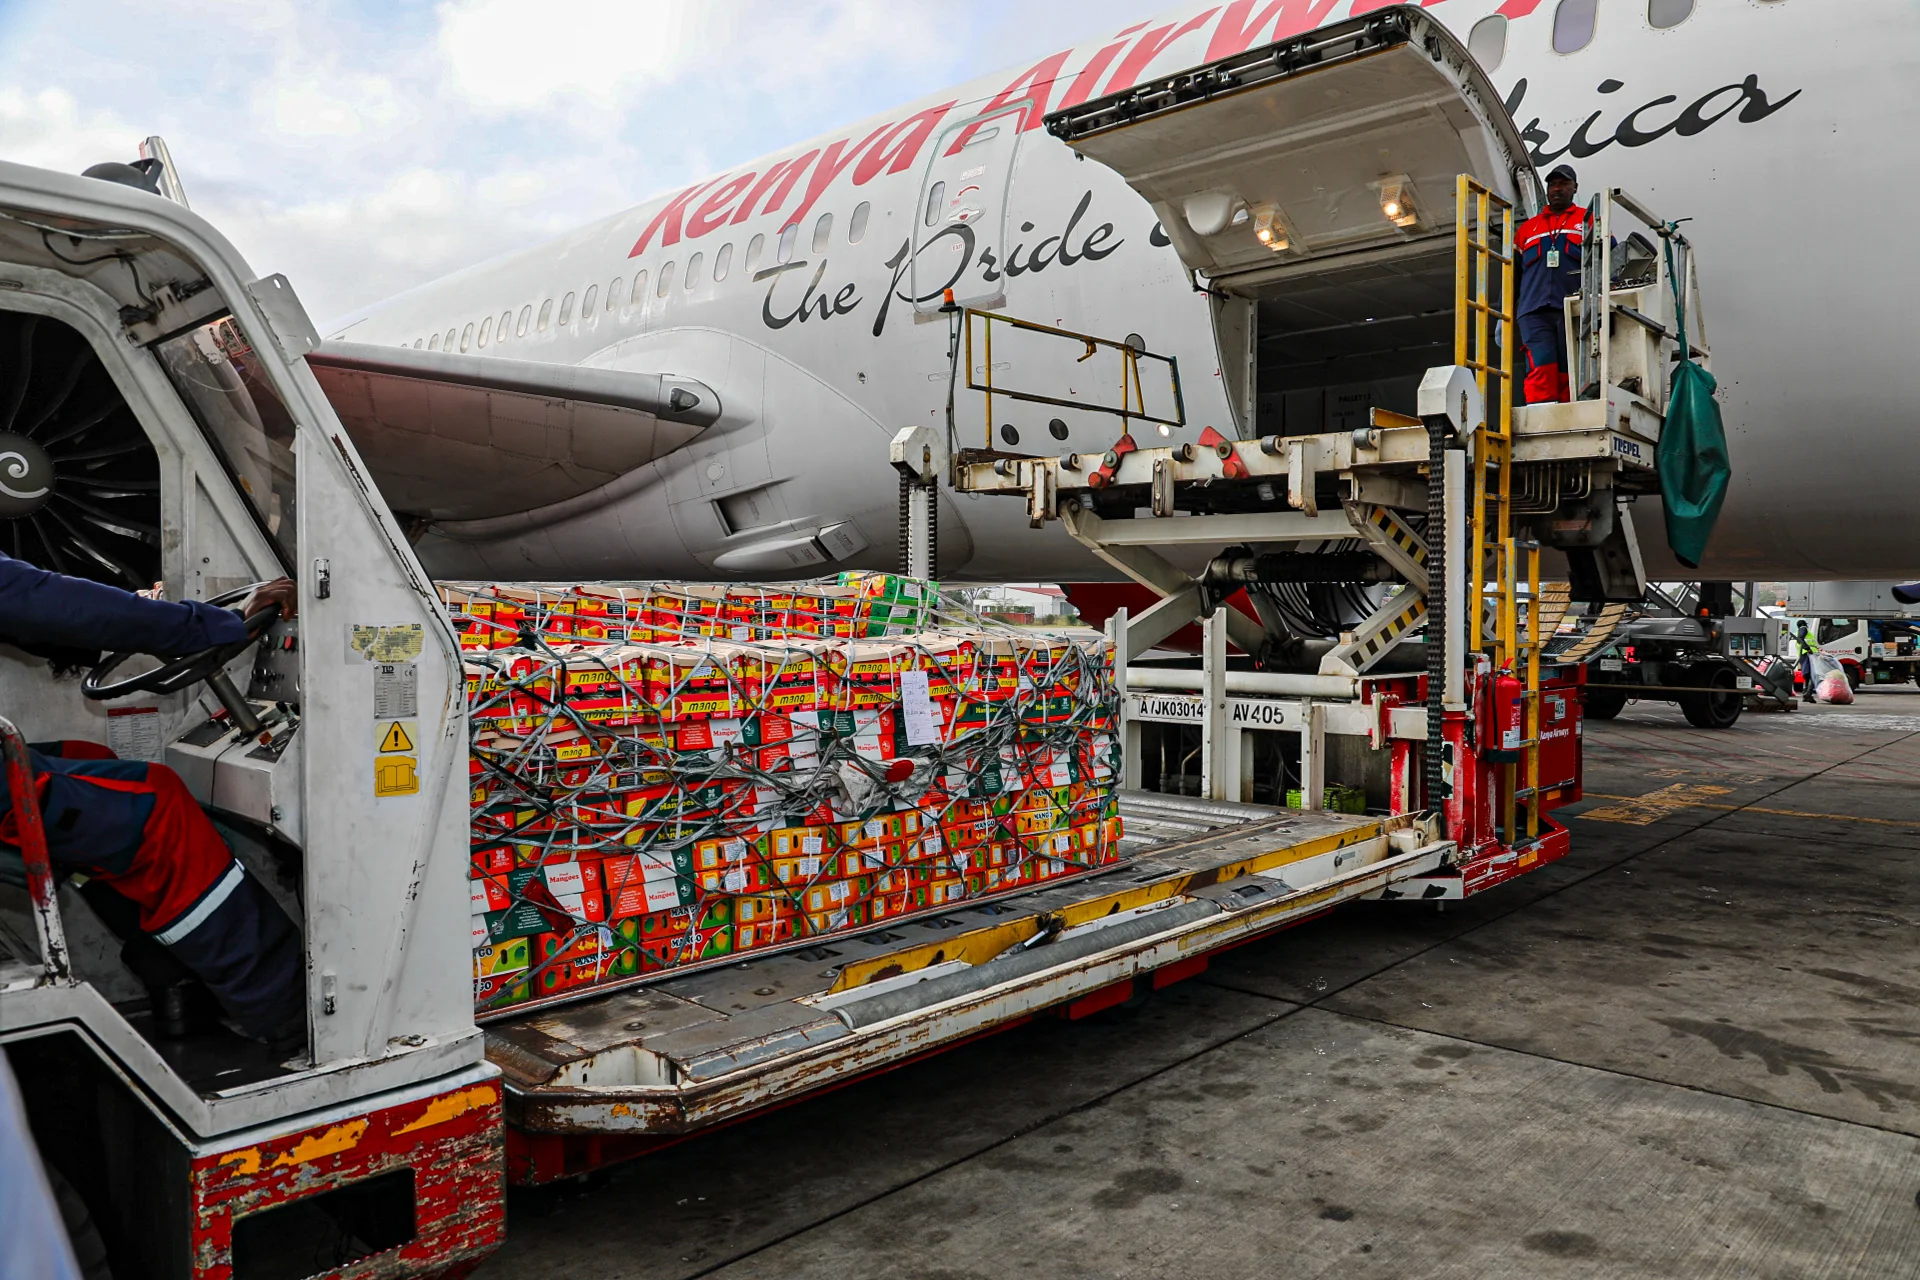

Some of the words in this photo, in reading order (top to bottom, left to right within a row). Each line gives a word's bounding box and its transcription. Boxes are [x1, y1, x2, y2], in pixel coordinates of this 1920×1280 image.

[627, 99, 958, 259] Kenya
[952, 243, 964, 251] EXIT
[752, 258, 863, 329] The
[872, 189, 1125, 337] Pride
[1613, 436, 1641, 458] TREPEL
[381, 665, 395, 674] TLD
[858, 663, 889, 673] mango
[780, 694, 811, 704] mango
[689, 702, 724, 712] mango
[1034, 812, 1053, 820] MANGO
[550, 874, 580, 883] Mangoes
[648, 891, 676, 900] Mangoes
